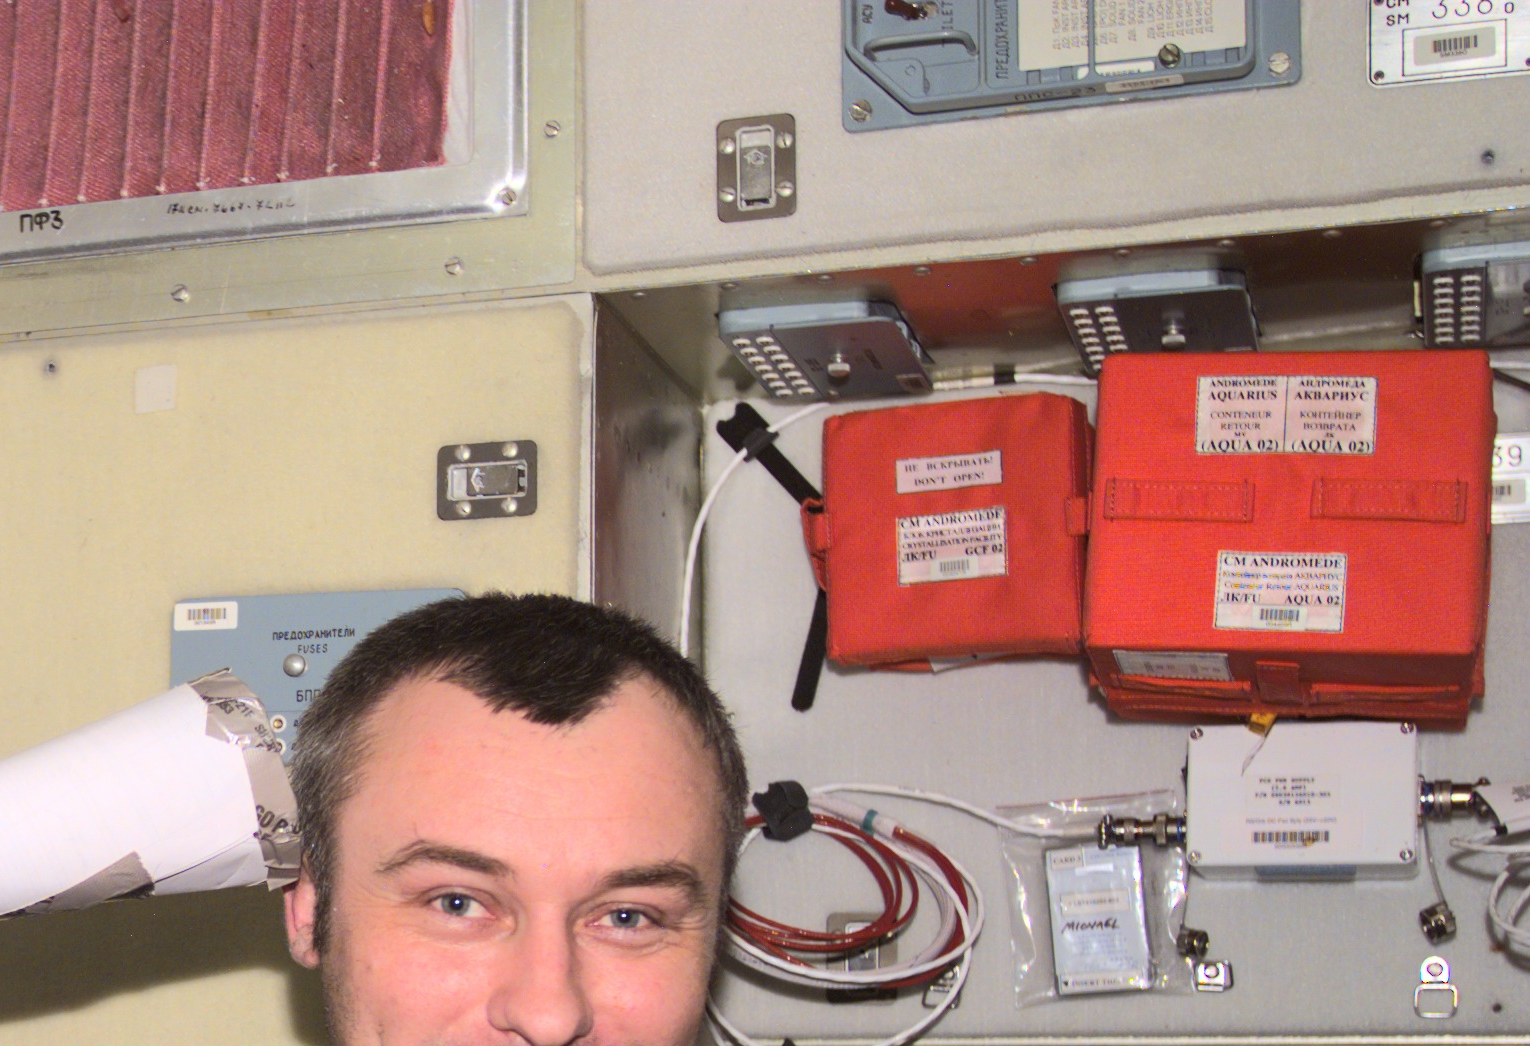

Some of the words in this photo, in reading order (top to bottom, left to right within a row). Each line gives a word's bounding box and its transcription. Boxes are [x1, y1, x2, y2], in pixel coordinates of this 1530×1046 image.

[1386, 13, 1410, 26] SM
[1210, 379, 1277, 388] ANDROMEDE
[1208, 391, 1278, 402] AQUARIUS
[1295, 391, 1369, 401] АКВАРИУС
[1220, 422, 1261, 430] RETOUR
[1201, 439, 1252, 452] (AQUA
[1257, 440, 1279, 451] 02)
[1291, 440, 1343, 452] (AQUA
[1348, 441, 1370, 452] 02)
[914, 476, 945, 486] DON'T
[953, 472, 985, 482] OPEN!
[991, 544, 1003, 553] 02
[1224, 557, 1246, 567] CM
[1250, 557, 1343, 568] ANDROMEDE
[1284, 594, 1322, 605] AQUA
[1326, 596, 1340, 605] 02
[272, 628, 355, 640] ПРЕДОХРАНИТЕЛИ
[297, 643, 328, 653] FUSES
